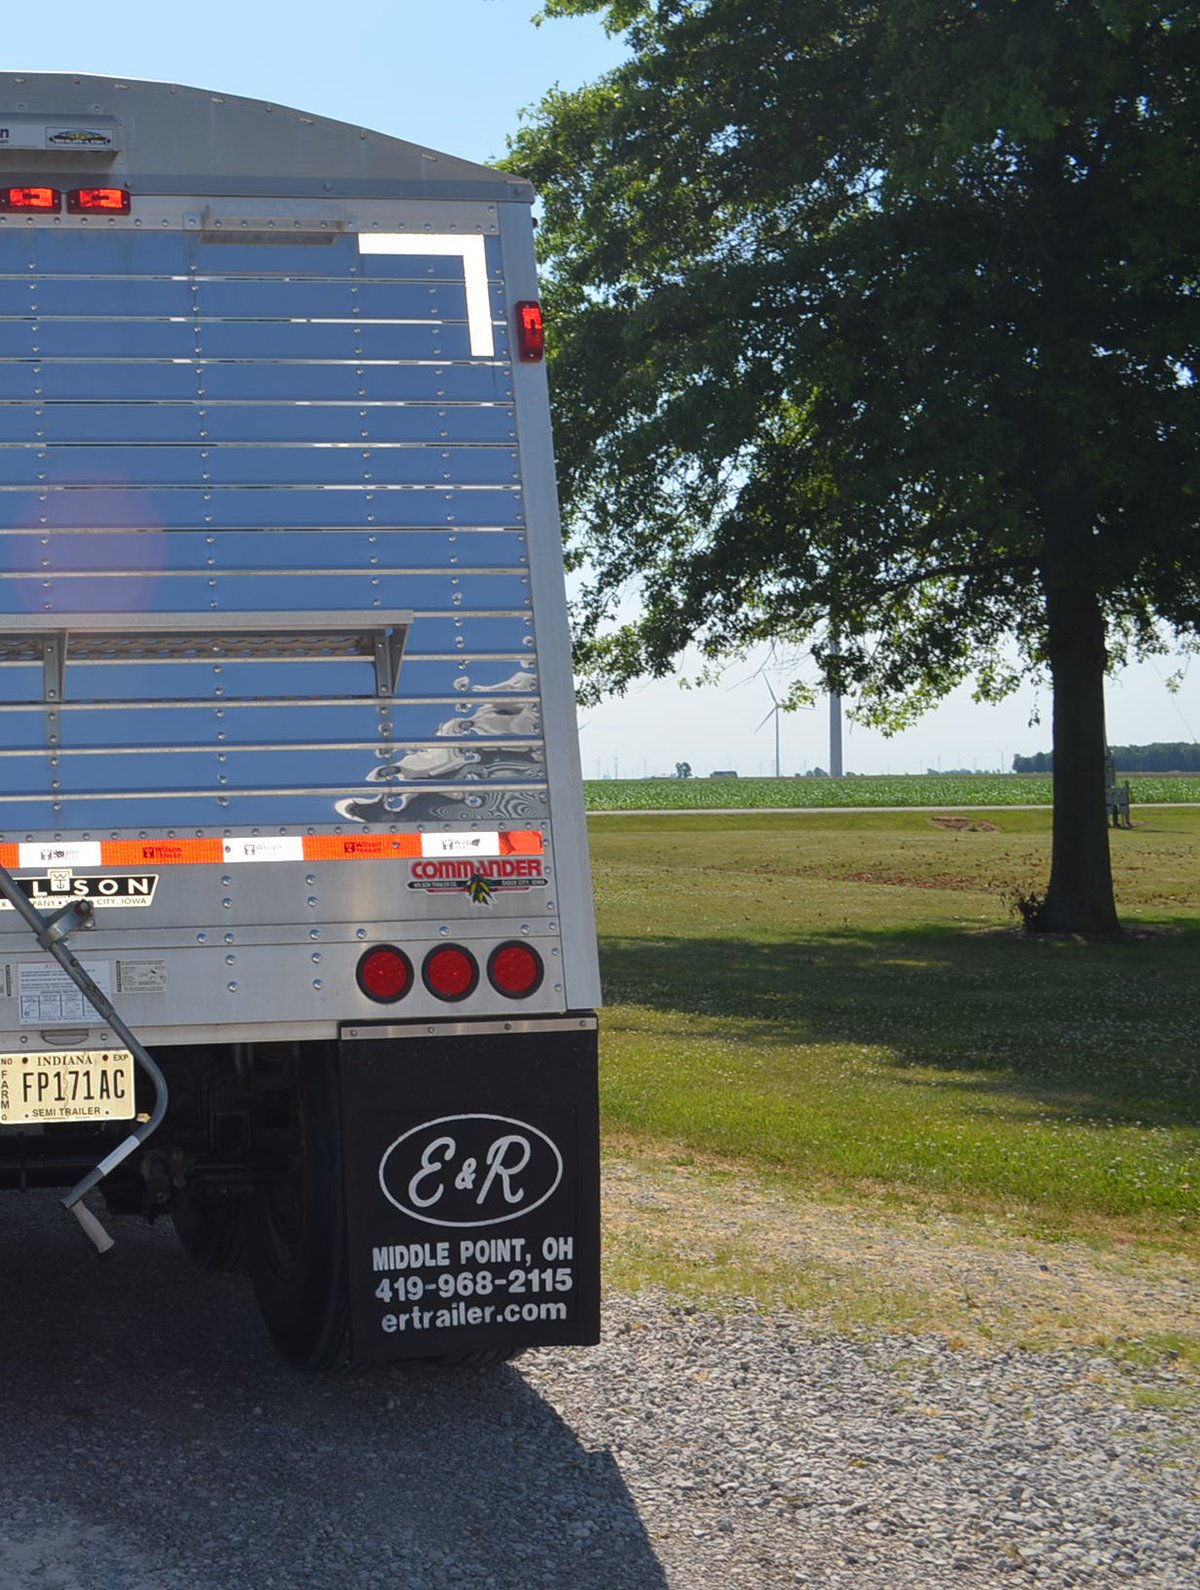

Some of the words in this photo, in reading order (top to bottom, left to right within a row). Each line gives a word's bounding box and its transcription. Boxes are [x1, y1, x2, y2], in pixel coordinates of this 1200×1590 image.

[411, 858, 542, 879] COMMANDER
[121, 897, 147, 905] IOWA
[37, 1055, 93, 1067] INDIANA
[113, 1054, 129, 1062] EXP
[22, 1069, 126, 1103] FP171AC
[32, 1108, 56, 1118] SEMI
[59, 1107, 101, 1117] TRAILER
[372, 1242, 450, 1272] MIDDLE
[460, 1238, 532, 1267] POINT,
[542, 1236, 574, 1261] OH
[375, 1268, 573, 1303] 419-968-2115
[382, 1301, 567, 1333] ertrailer.com
